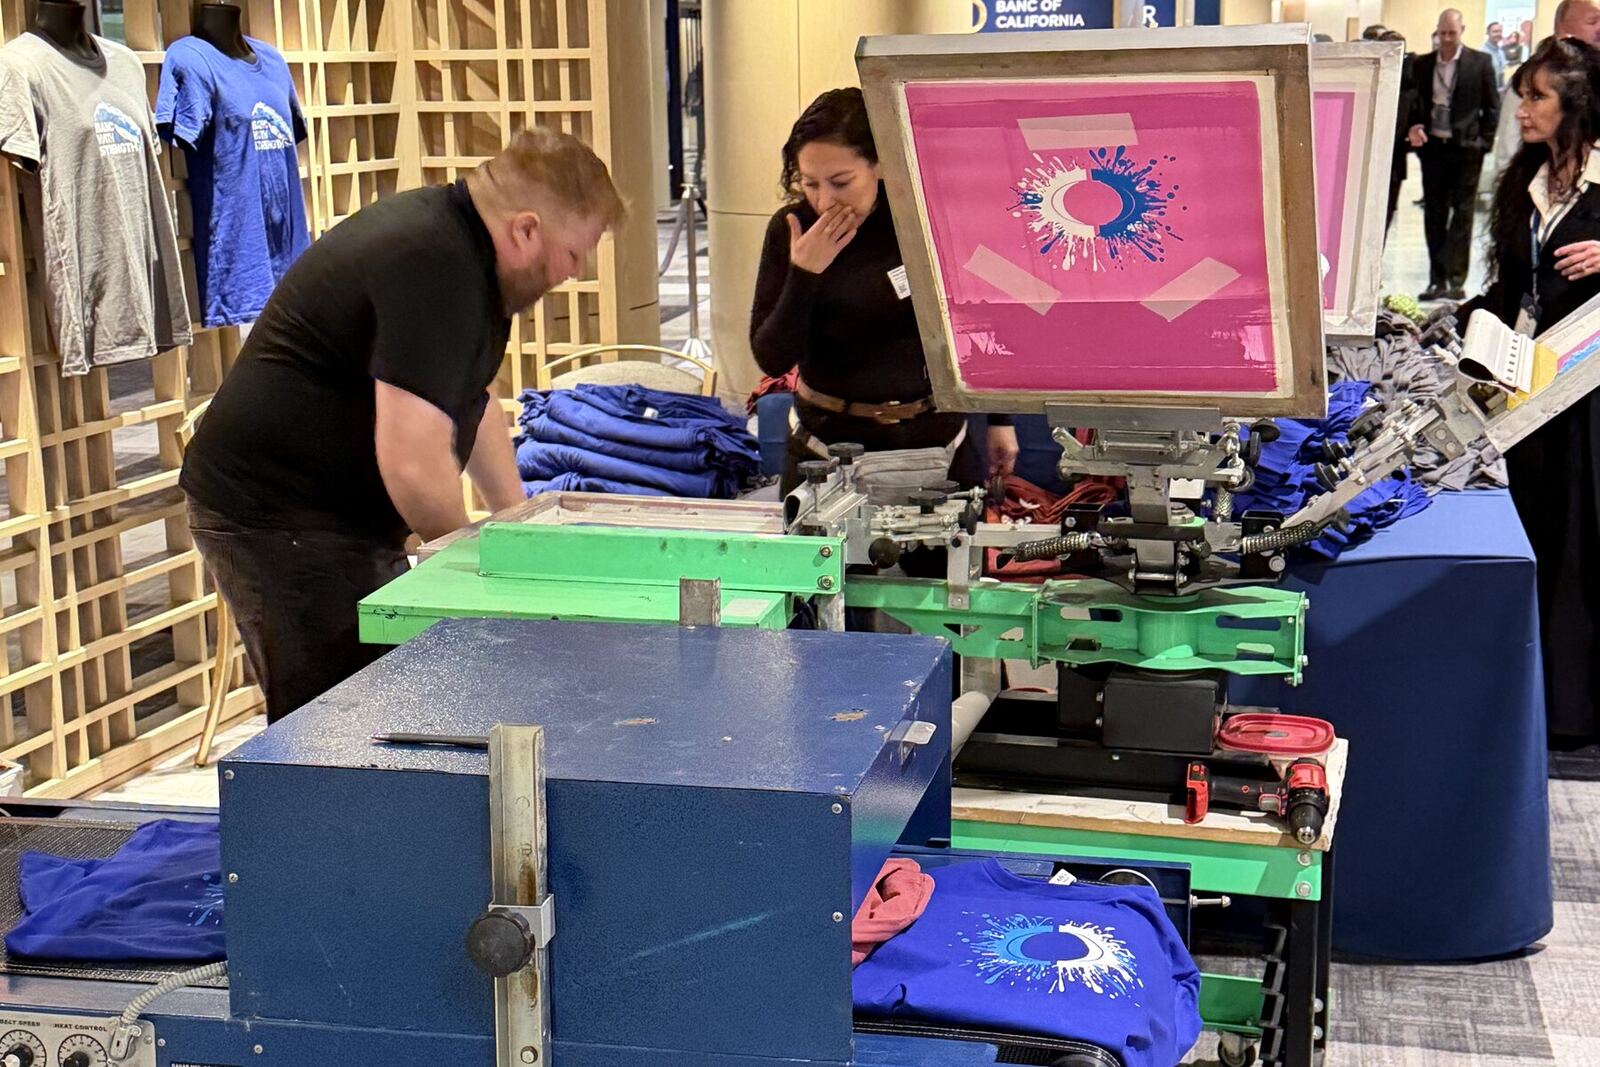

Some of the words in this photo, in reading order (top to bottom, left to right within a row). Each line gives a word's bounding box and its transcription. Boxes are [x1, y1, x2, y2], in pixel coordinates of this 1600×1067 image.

[996, 0, 1037, 12] BANC
[1040, 0, 1062, 11] OF
[996, 14, 1085, 28] CALIFORNIA
[75, 1024, 107, 1032] CONTROL
